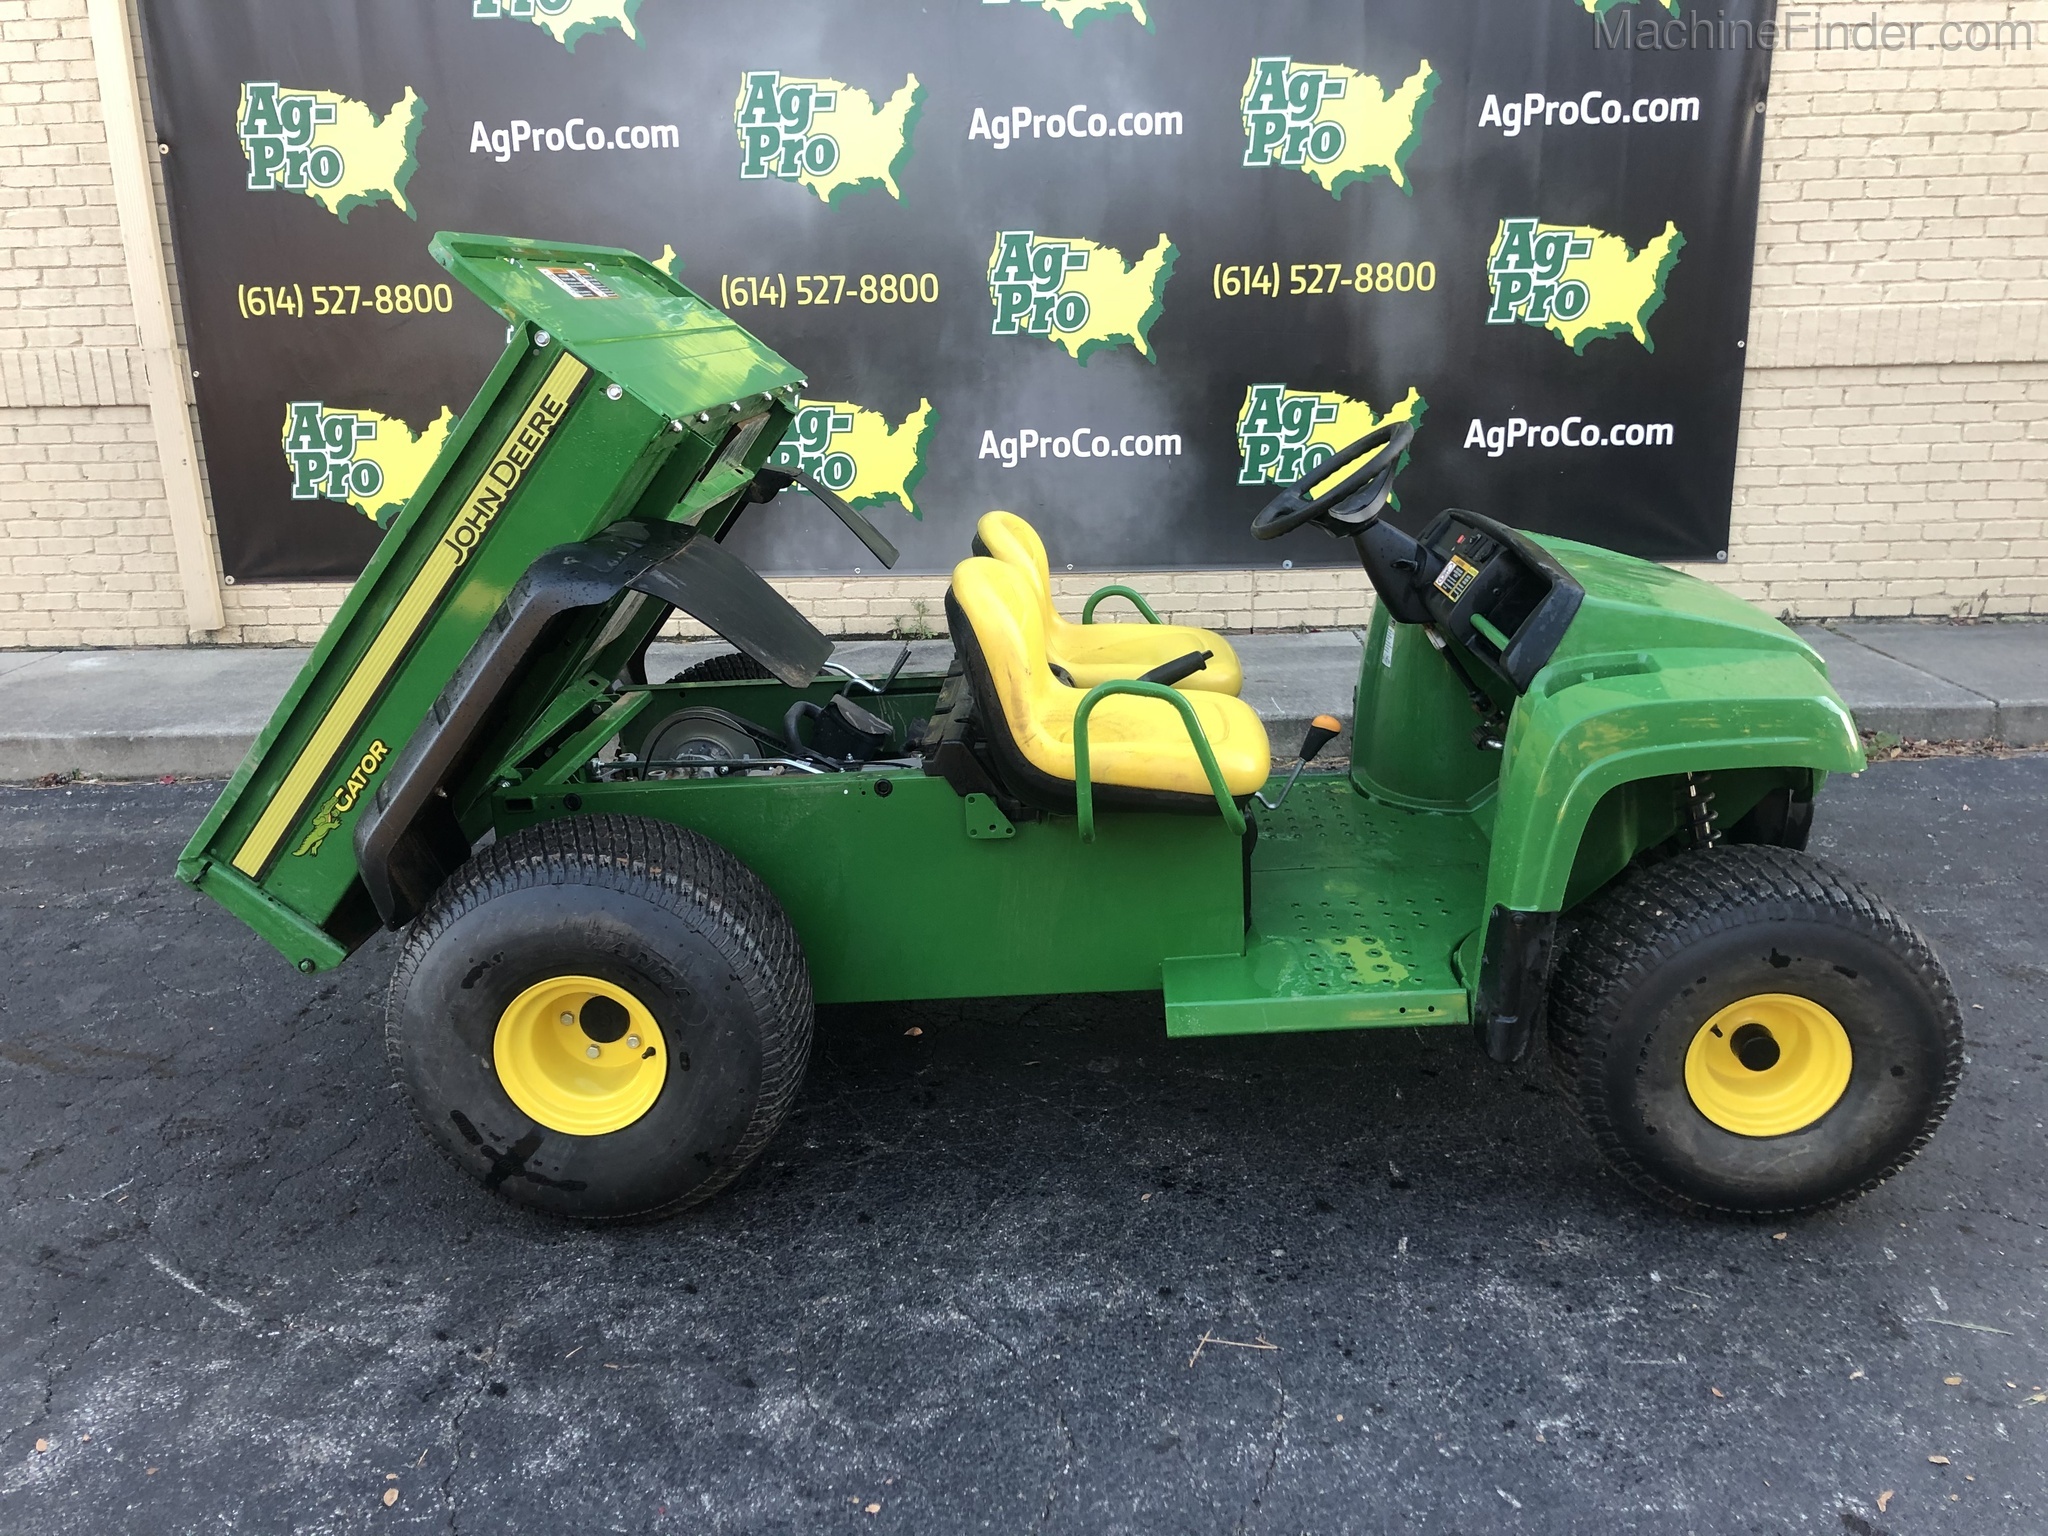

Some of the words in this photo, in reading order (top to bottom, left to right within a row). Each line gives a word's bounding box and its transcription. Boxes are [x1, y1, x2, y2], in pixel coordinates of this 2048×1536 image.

[240, 82, 336, 146] Ag-
[737, 71, 836, 136] Ag-
[1243, 56, 1347, 122] Ag-
[1479, 91, 1700, 136] AgProCo.com
[470, 118, 680, 162] AgProCo.com
[741, 126, 839, 179] Pro
[968, 104, 1183, 149] AgProCo.com
[1243, 113, 1346, 166] Pro
[247, 136, 344, 189] Pro
[990, 231, 1089, 294] Ag-
[1489, 218, 1593, 283] Ag-
[238, 286, 303, 317] (614)
[311, 284, 453, 315] 527-8800
[722, 279, 786, 307] (614)
[797, 275, 938, 305] 527-8800
[1214, 264, 1279, 297] (614)
[1291, 262, 1434, 294] 527-8800
[1487, 272, 1589, 323] Pro
[992, 284, 1089, 335] Pro
[286, 403, 376, 461] Ag-
[1239, 384, 1338, 444] Ag-
[1464, 417, 1674, 458] AgProCo.com
[979, 428, 1182, 468] AgProCo.com
[1238, 436, 1337, 484] Pro
[291, 452, 383, 499] Pro
[444, 486, 503, 565] JOHN
[489, 393, 564, 489] DEERE
[335, 739, 388, 812] GATOR
